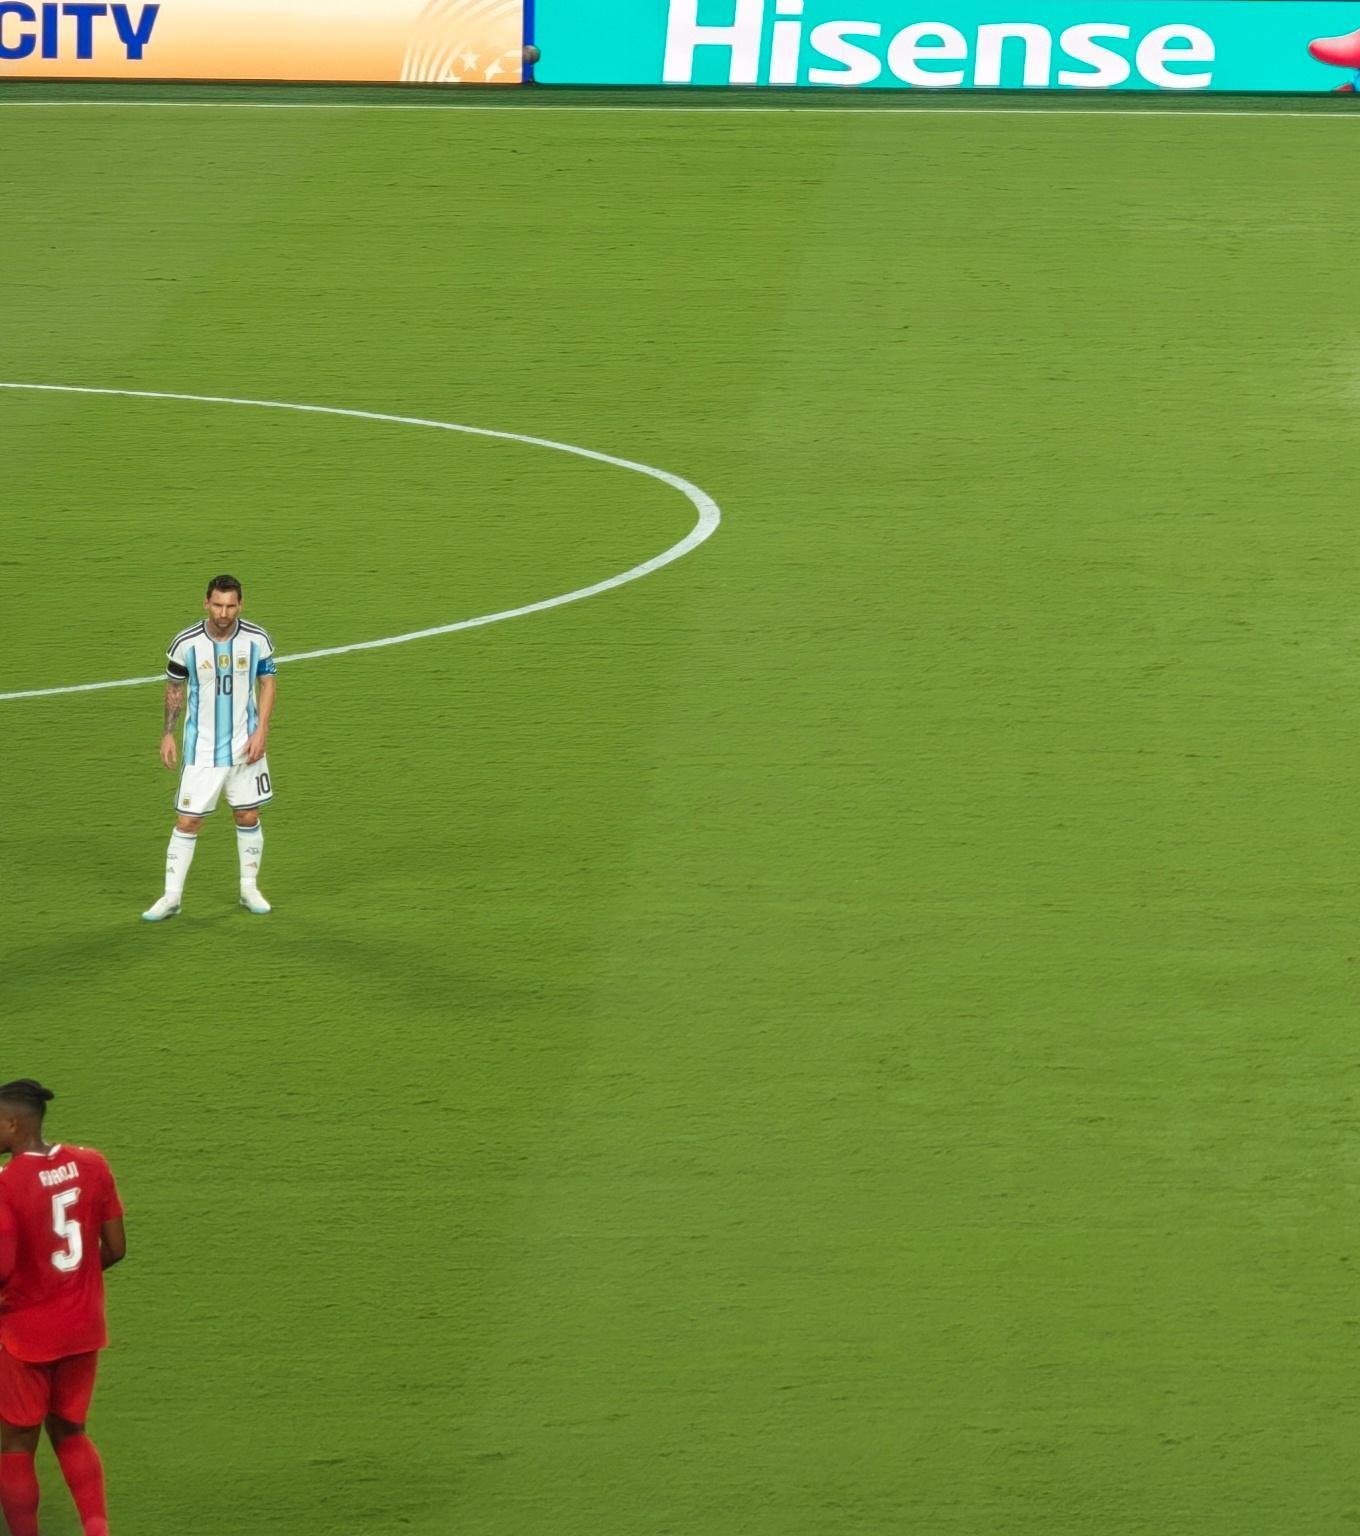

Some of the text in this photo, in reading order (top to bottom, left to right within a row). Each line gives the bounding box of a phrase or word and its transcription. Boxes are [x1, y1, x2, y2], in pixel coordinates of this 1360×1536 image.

[0, 1, 160, 59] CITY
[255, 772, 271, 796] 10
[51, 1187, 83, 1272] 5
